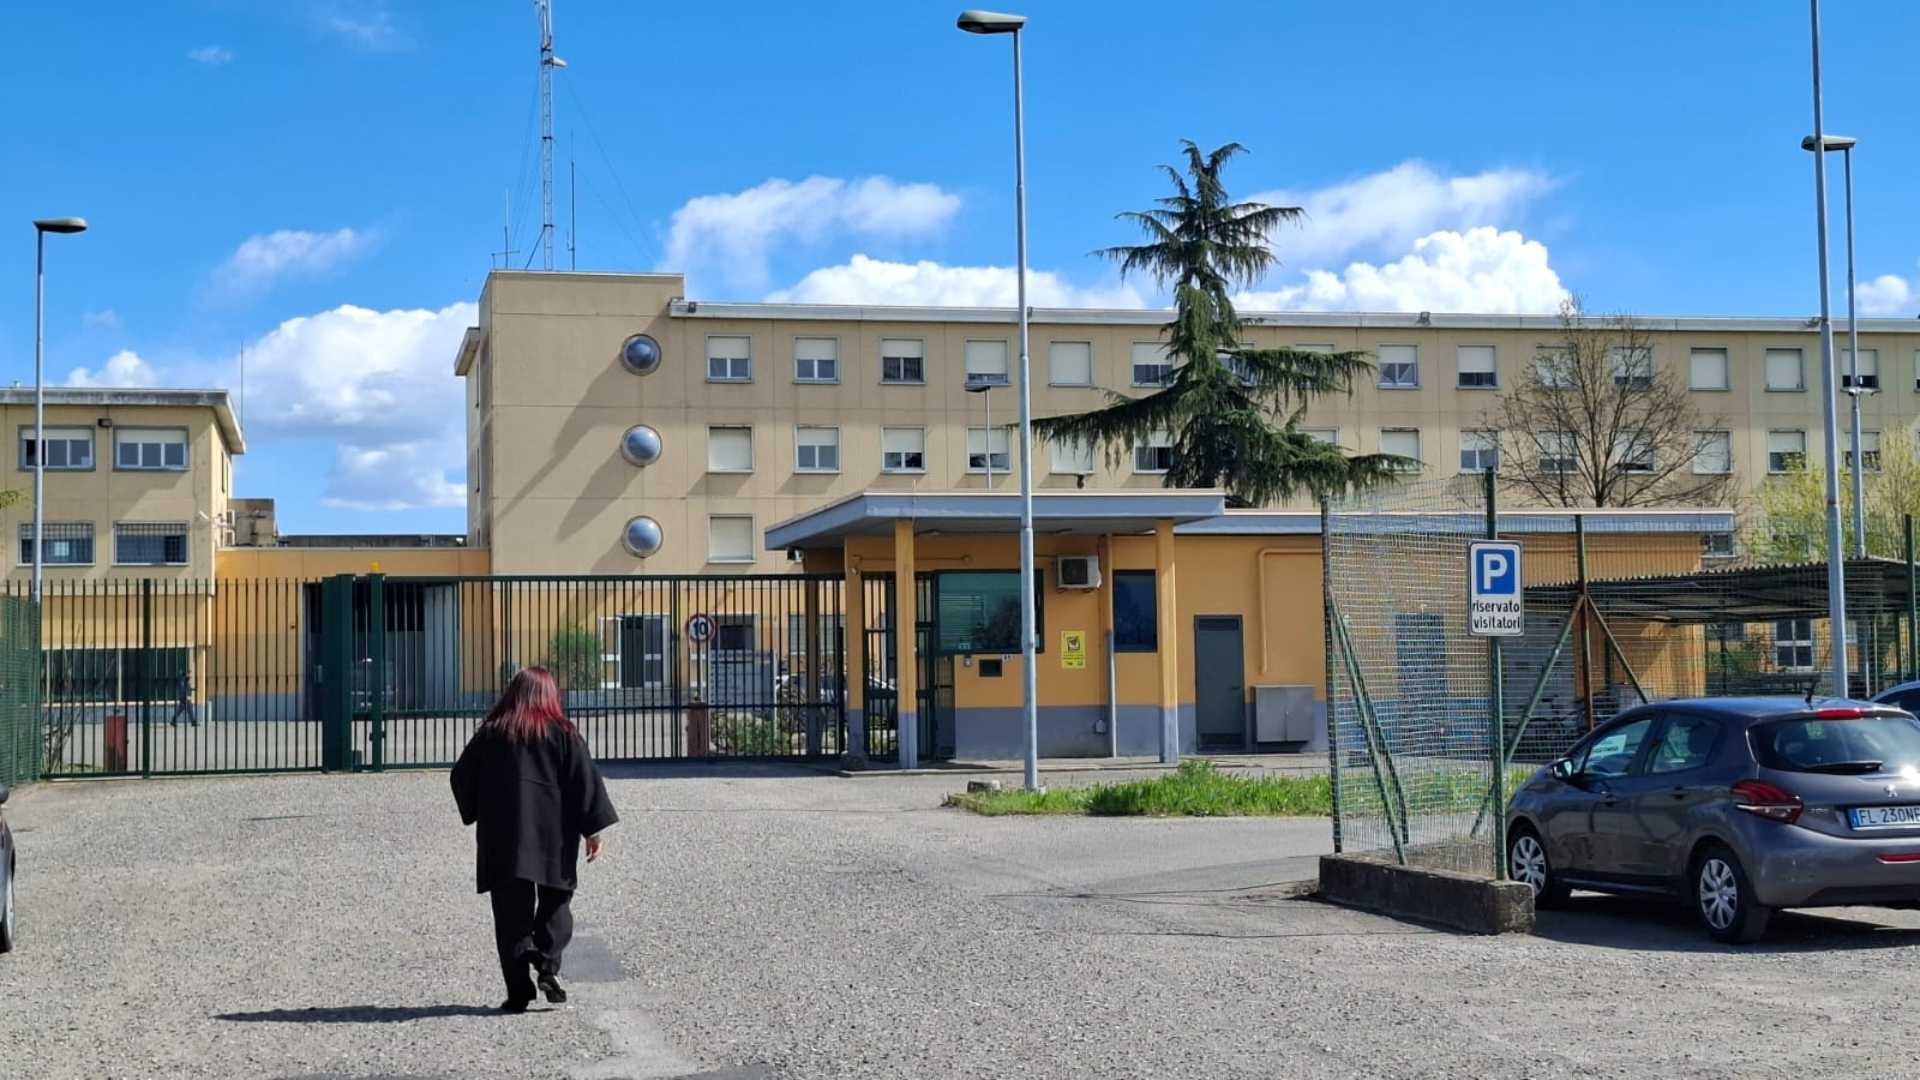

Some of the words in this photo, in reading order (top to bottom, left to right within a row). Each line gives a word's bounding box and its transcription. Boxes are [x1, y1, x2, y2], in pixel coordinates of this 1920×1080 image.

[1483, 553, 1508, 590] P
[1472, 600, 1520, 613] riservato
[1473, 615, 1520, 629] visitatori
[1859, 808, 1877, 824] FL
